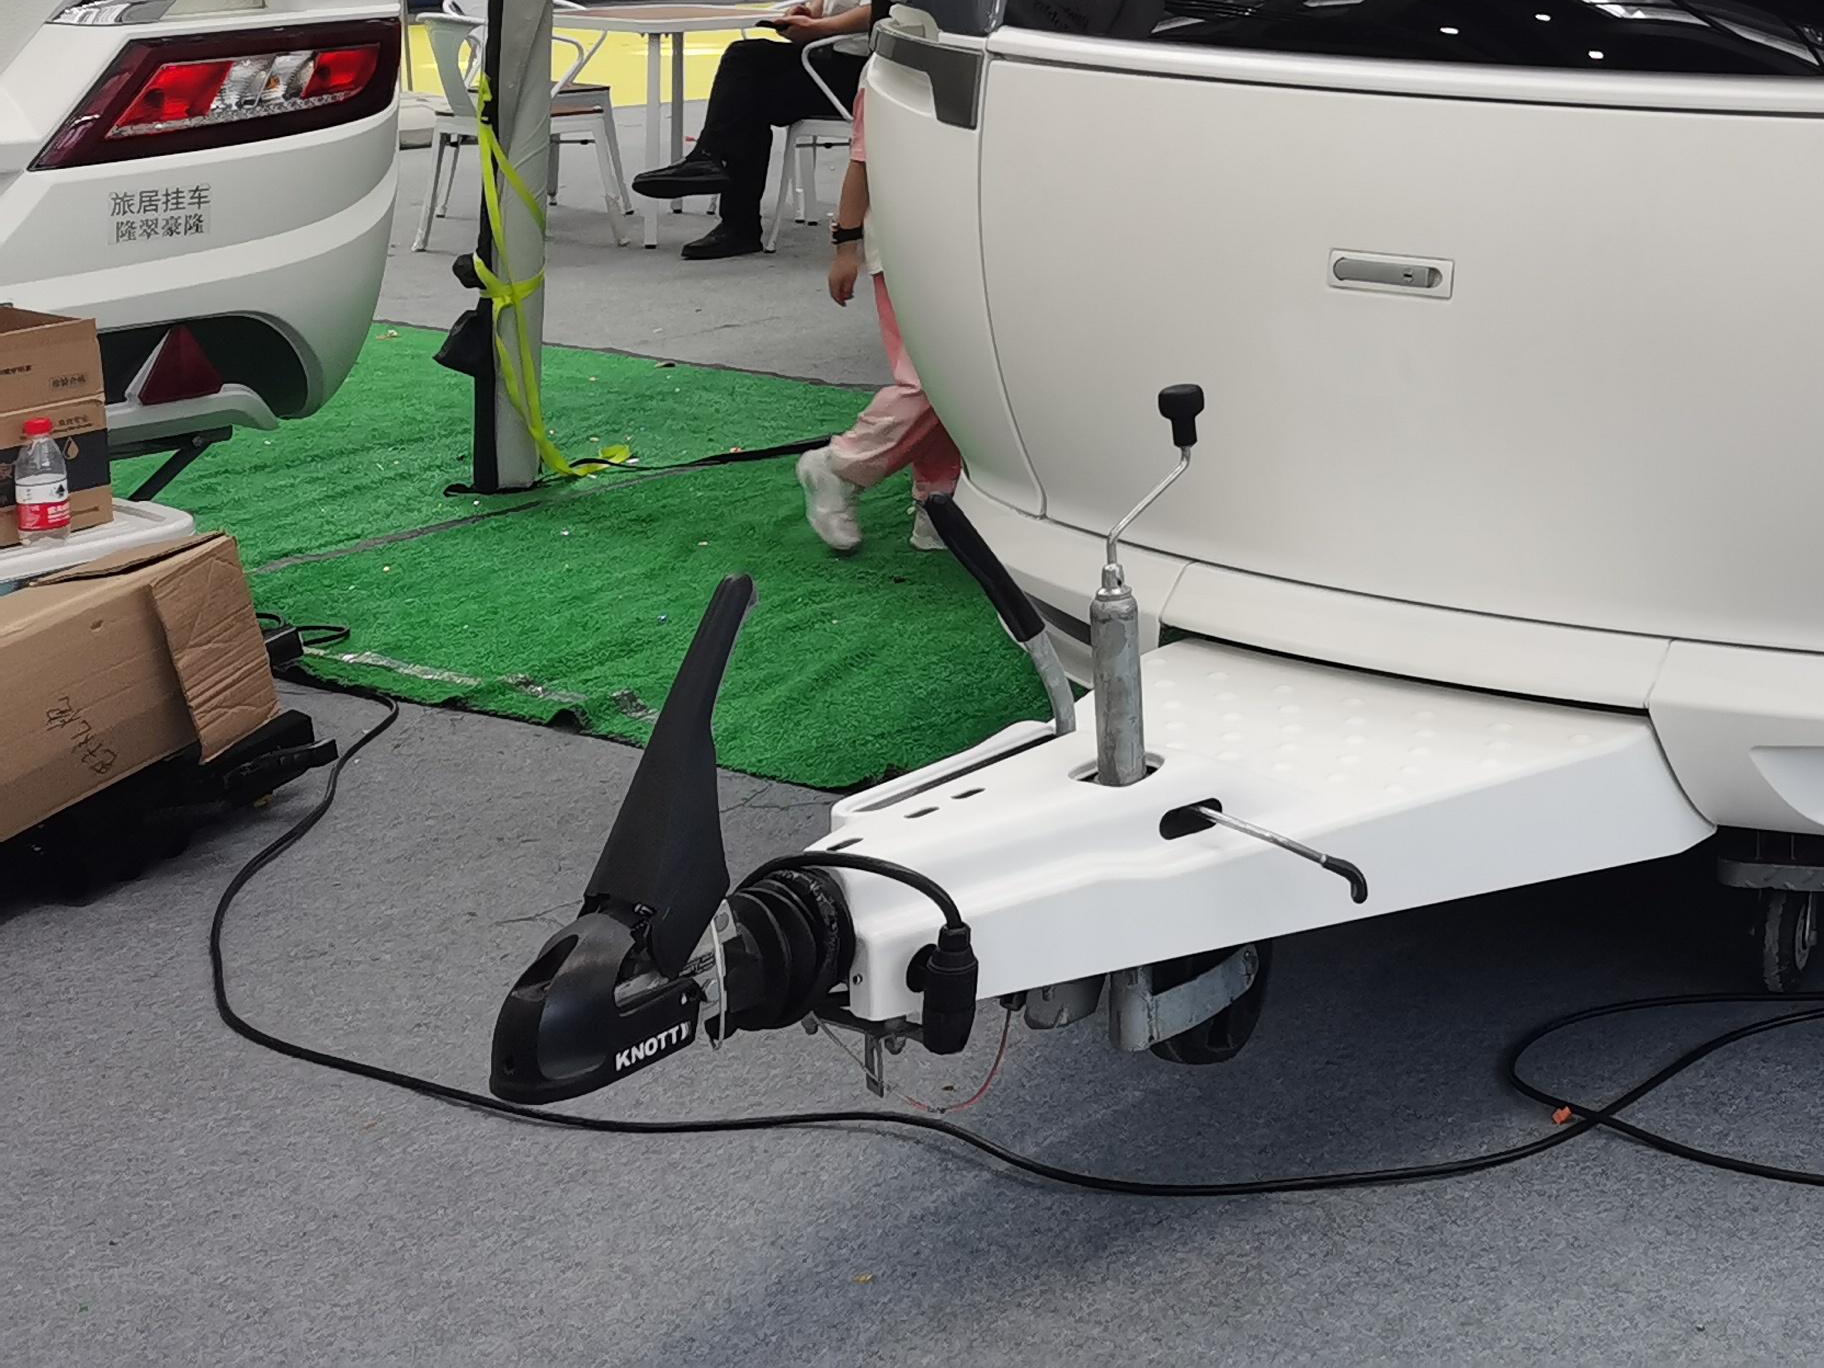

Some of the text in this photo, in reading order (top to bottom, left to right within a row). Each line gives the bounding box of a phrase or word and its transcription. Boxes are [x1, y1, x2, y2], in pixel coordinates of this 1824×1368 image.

[110, 184, 212, 216] 旅居挂车
[614, 1023, 682, 1072] KNOTT
